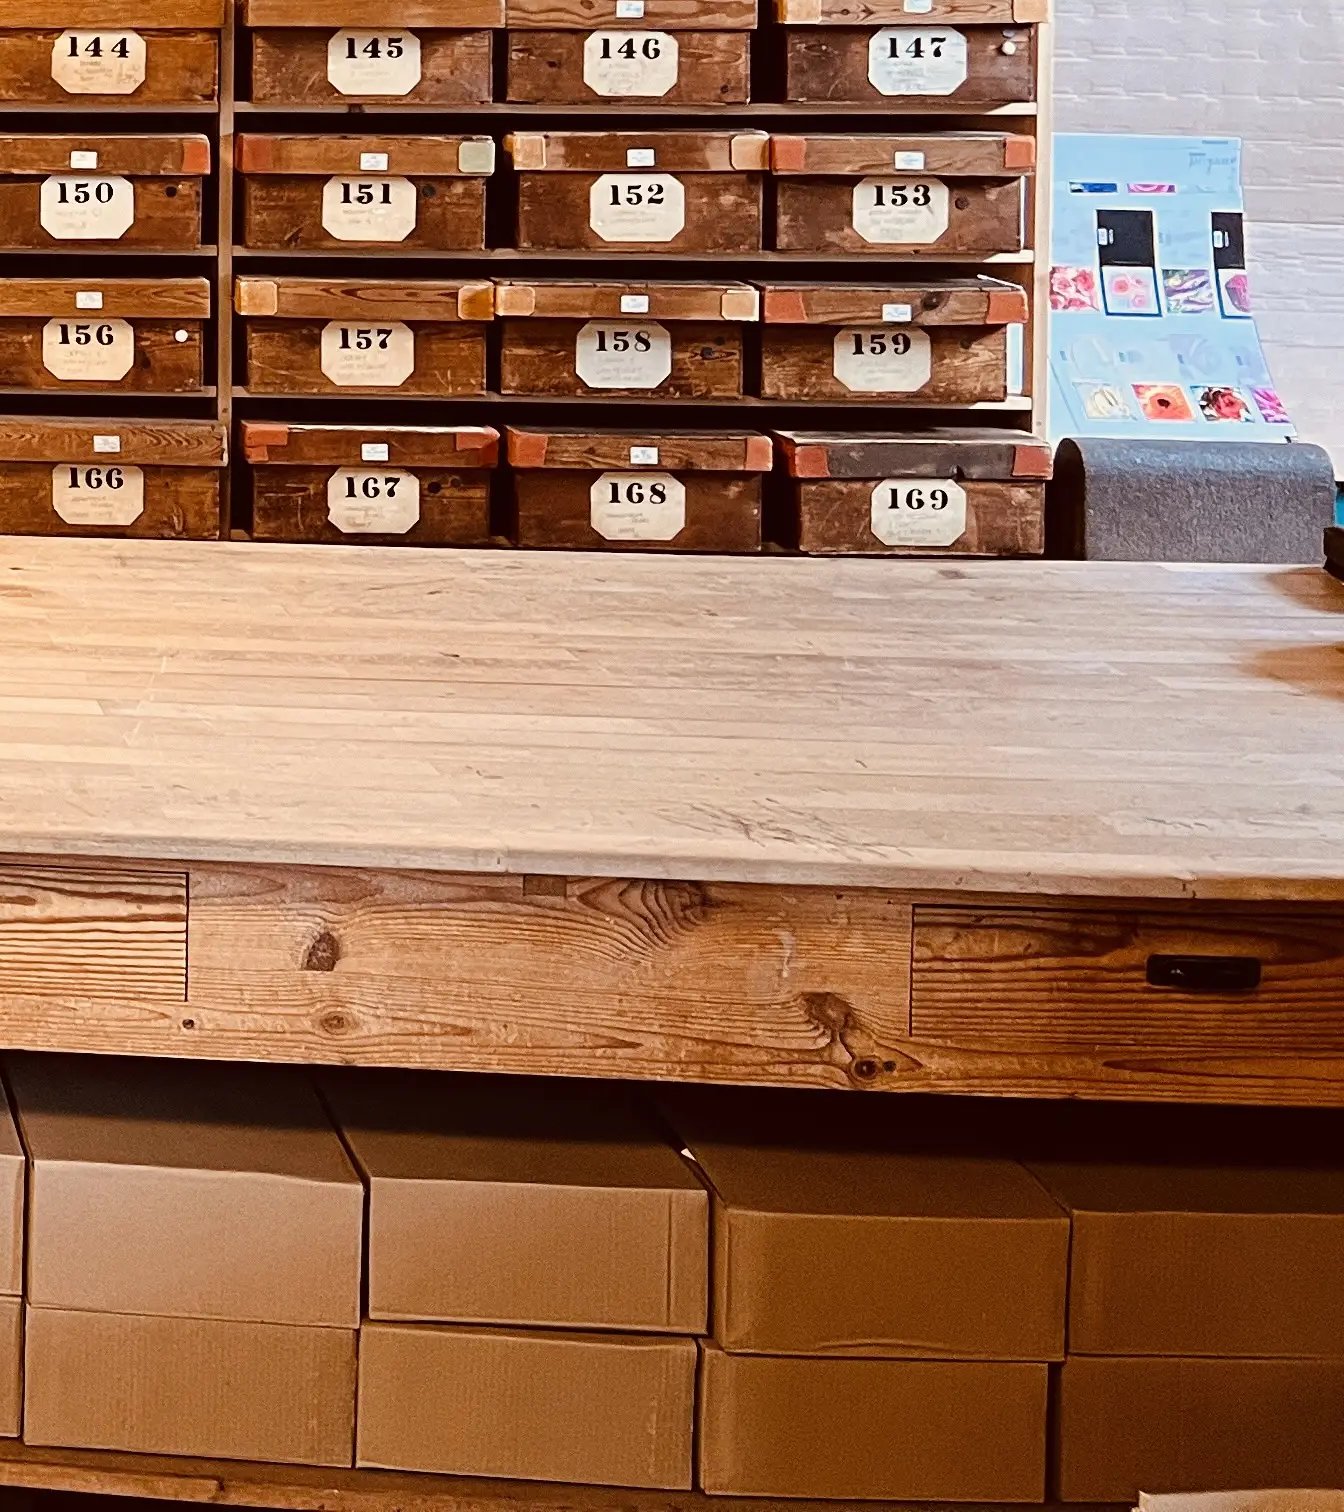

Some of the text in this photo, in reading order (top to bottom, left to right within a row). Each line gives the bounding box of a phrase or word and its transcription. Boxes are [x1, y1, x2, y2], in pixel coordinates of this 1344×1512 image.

[67, 36, 130, 59] 144
[345, 37, 404, 58] 145
[599, 37, 661, 60] 146
[888, 37, 947, 58] 147
[57, 182, 114, 204] 150
[340, 182, 392, 205] 151
[609, 183, 664, 206] 152
[873, 183, 932, 205] 153
[58, 323, 114, 346] 156
[339, 327, 393, 350] 157
[596, 329, 652, 353] 158
[851, 332, 912, 356] 159
[68, 466, 124, 490] 166
[345, 476, 401, 499] 167
[609, 482, 667, 505] 168
[887, 488, 949, 511] 169
